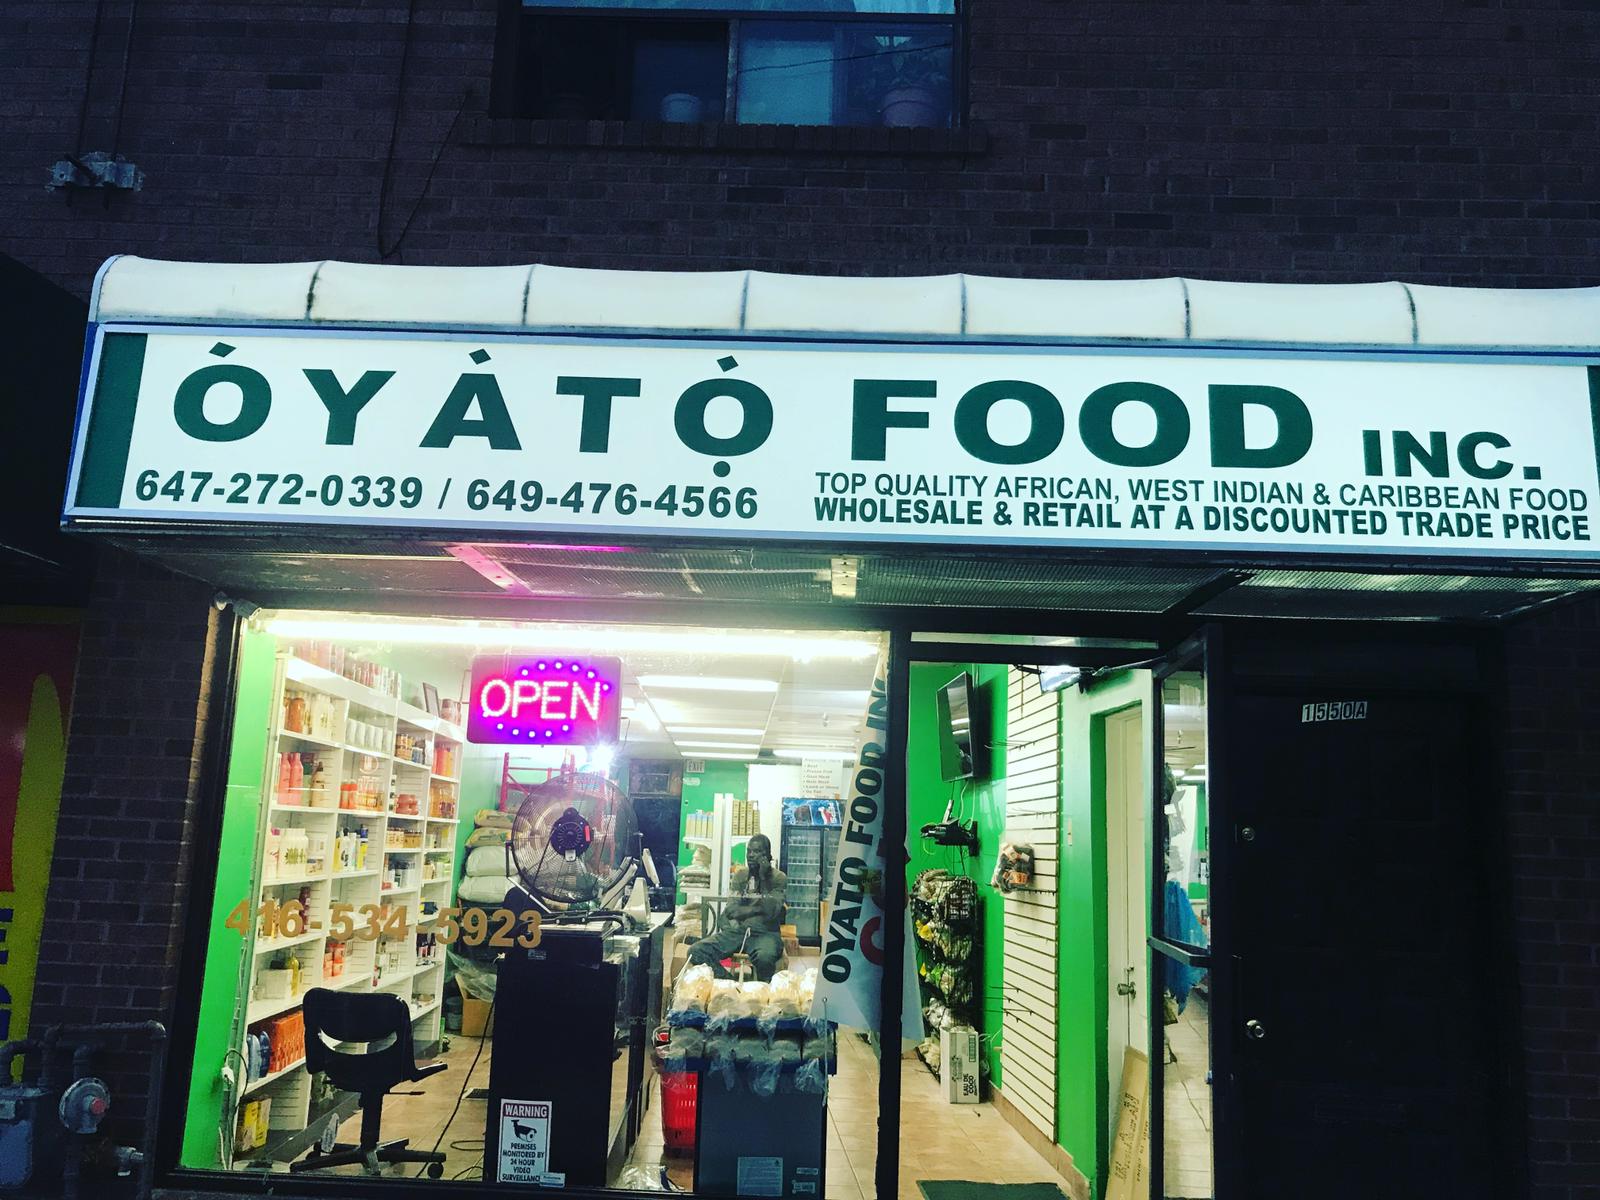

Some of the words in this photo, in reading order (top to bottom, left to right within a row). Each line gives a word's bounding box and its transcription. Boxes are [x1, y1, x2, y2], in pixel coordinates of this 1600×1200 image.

[851, 378, 1314, 468] FOOD
[1362, 429, 1542, 481] INC.
[136, 470, 423, 509] 647-272-0339
[467, 479, 758, 520] 649-476-4566
[816, 472, 867, 495] TOP
[875, 474, 988, 498] QUALITY
[994, 476, 1120, 504] AFRICAN,
[1128, 479, 1205, 502] WEST
[1213, 480, 1304, 505] INDIAN
[1313, 483, 1331, 506] &
[1340, 484, 1500, 510] CARIBBEAN
[1509, 488, 1588, 512] FOOD
[814, 497, 983, 525] WHOLESALE
[993, 501, 1013, 526] &
[1023, 502, 1122, 529] RETAIL
[1131, 505, 1166, 530] AT
[1175, 506, 1195, 531] A
[1204, 506, 1388, 536] DISCOUNTED
[1395, 510, 1494, 539] TRADE
[1503, 514, 1591, 541] PRICE
[480, 679, 601, 720] OPEN
[1302, 701, 1367, 722] 1550A
[821, 856, 868, 984] OYATO
[845, 741, 885, 846] FOOD
[225, 899, 543, 949] 416-534-5923
[505, 1104, 548, 1118] WARNING
[502, 1149, 536, 1158] MONITORED
[537, 1151, 544, 1159] BY
[510, 1142, 537, 1150] PREMISES
[502, 1174, 540, 1182] SURVEILLANC
[513, 1166, 531, 1174] VIDEO
